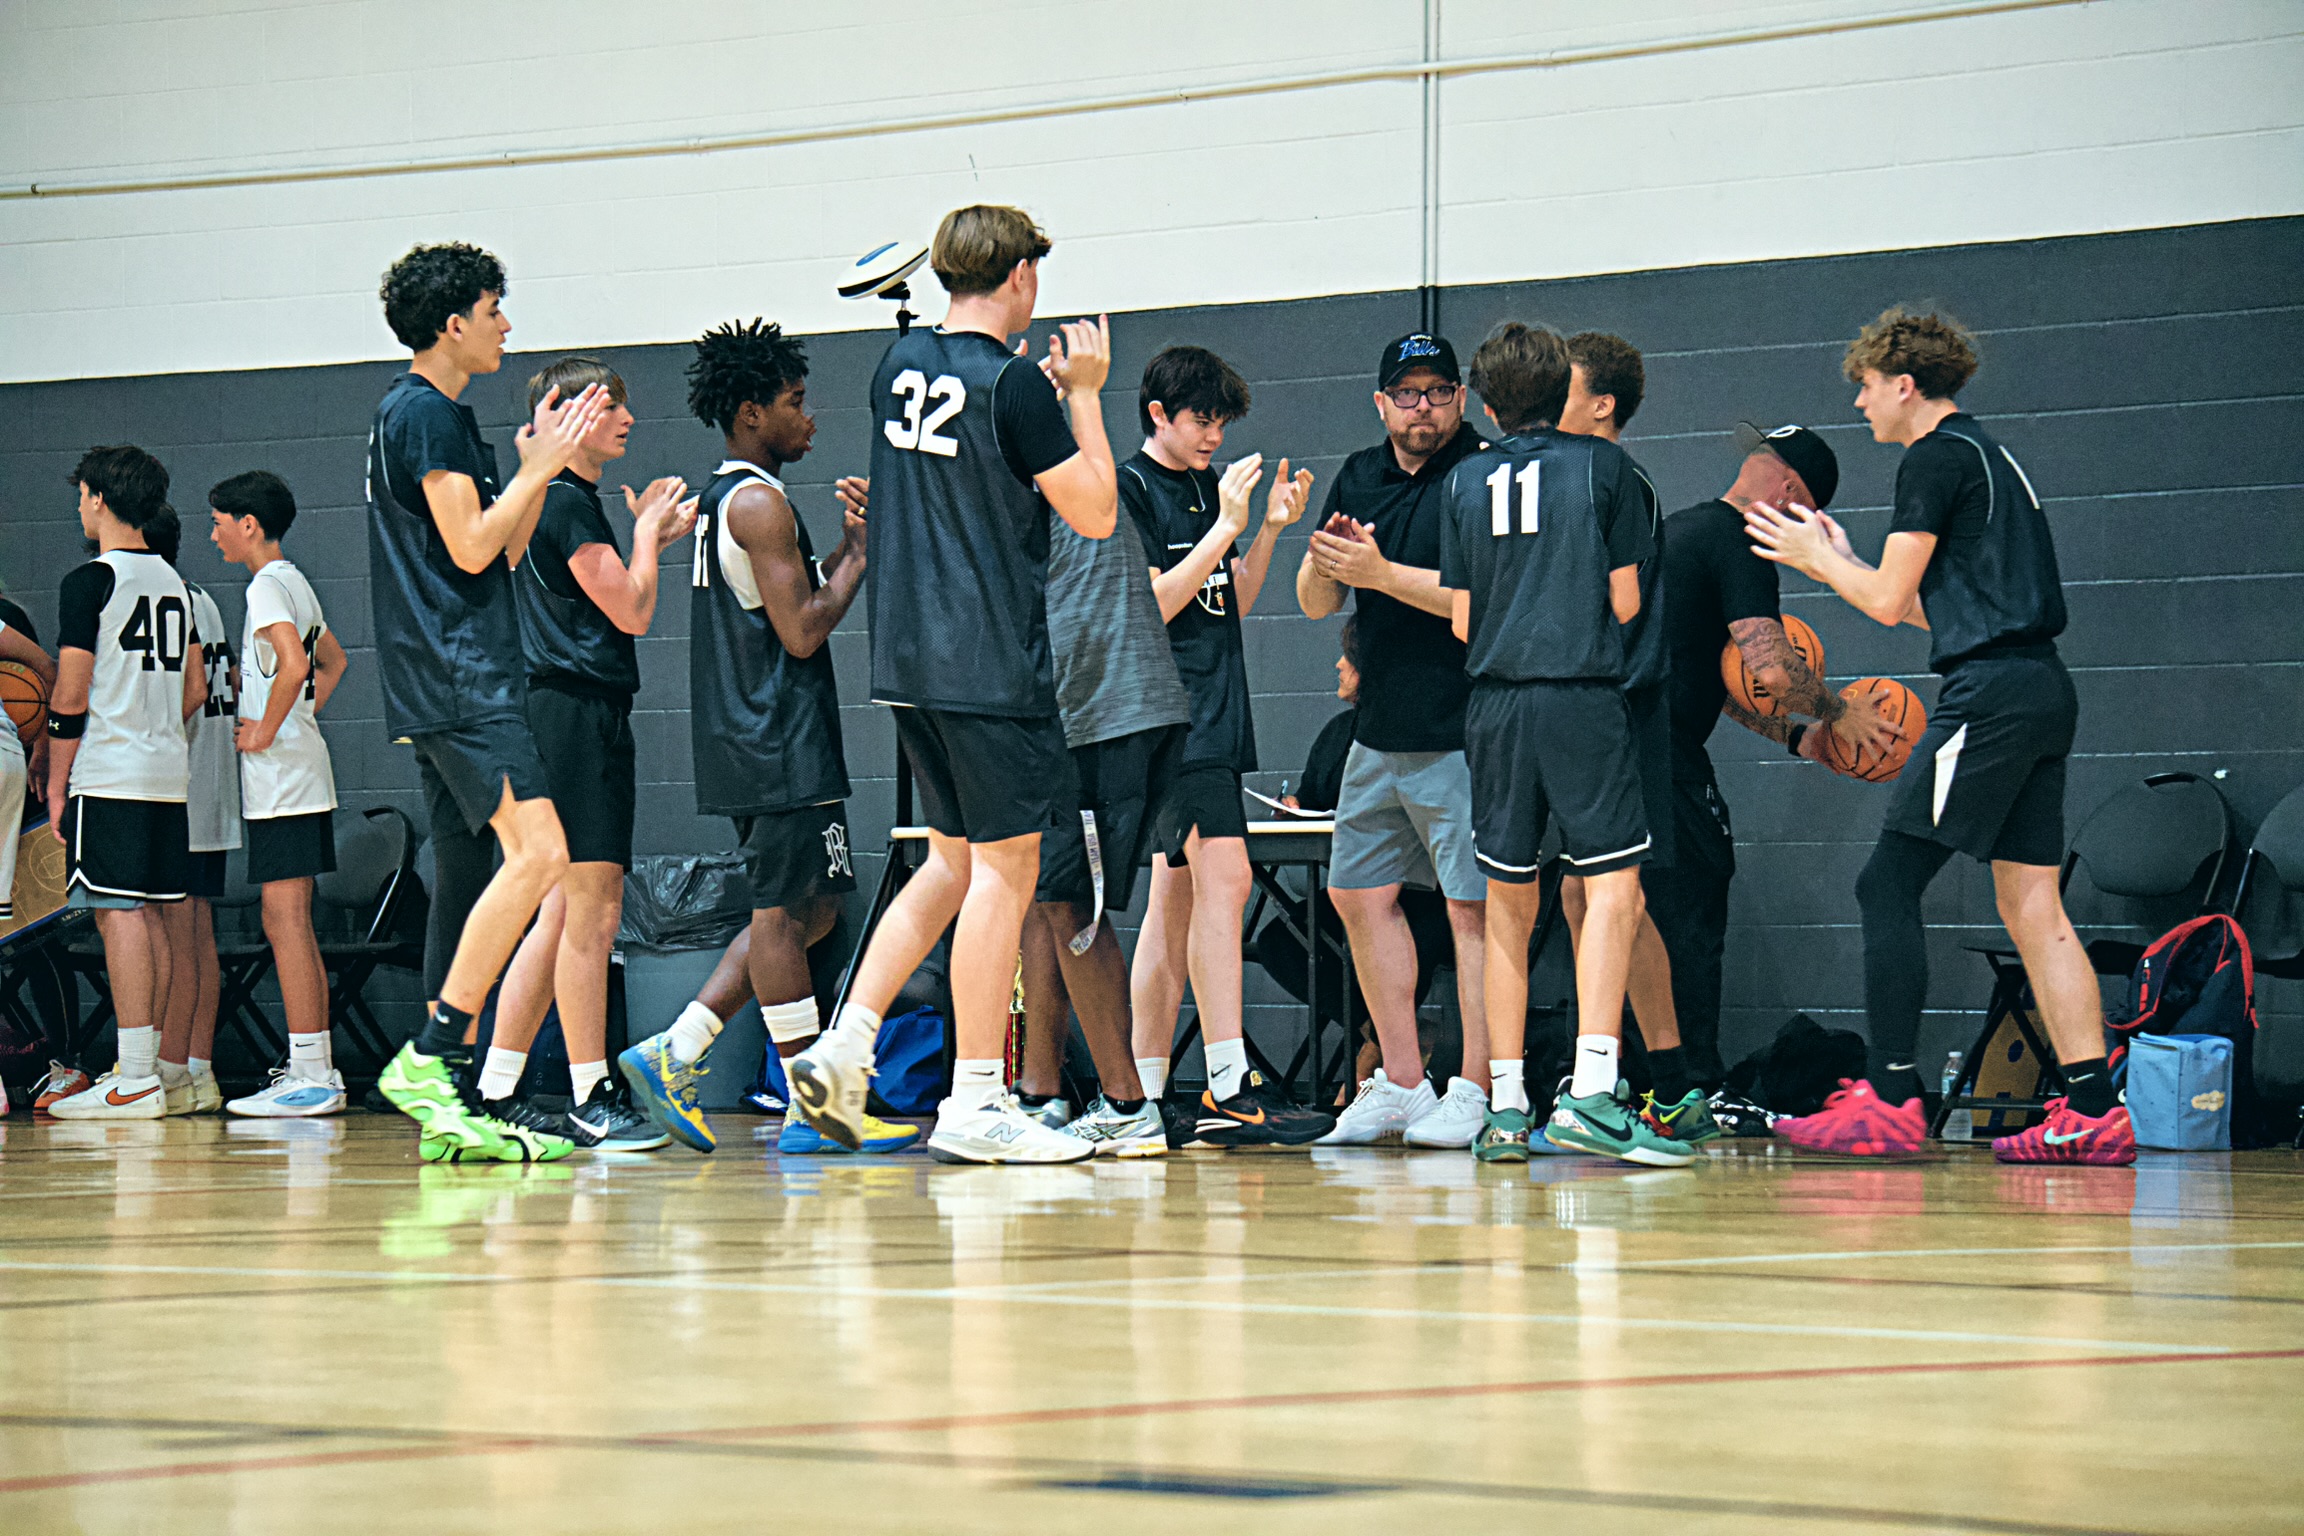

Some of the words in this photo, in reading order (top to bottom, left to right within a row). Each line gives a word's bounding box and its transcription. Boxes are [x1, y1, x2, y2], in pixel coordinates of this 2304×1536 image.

[884, 368, 967, 457] 32
[1486, 460, 1540, 536] 11
[119, 595, 186, 671] 40
[1087, 832, 1097, 847] USA
[1089, 847, 1100, 865] TEAM
[984, 1121, 1026, 1144] N
